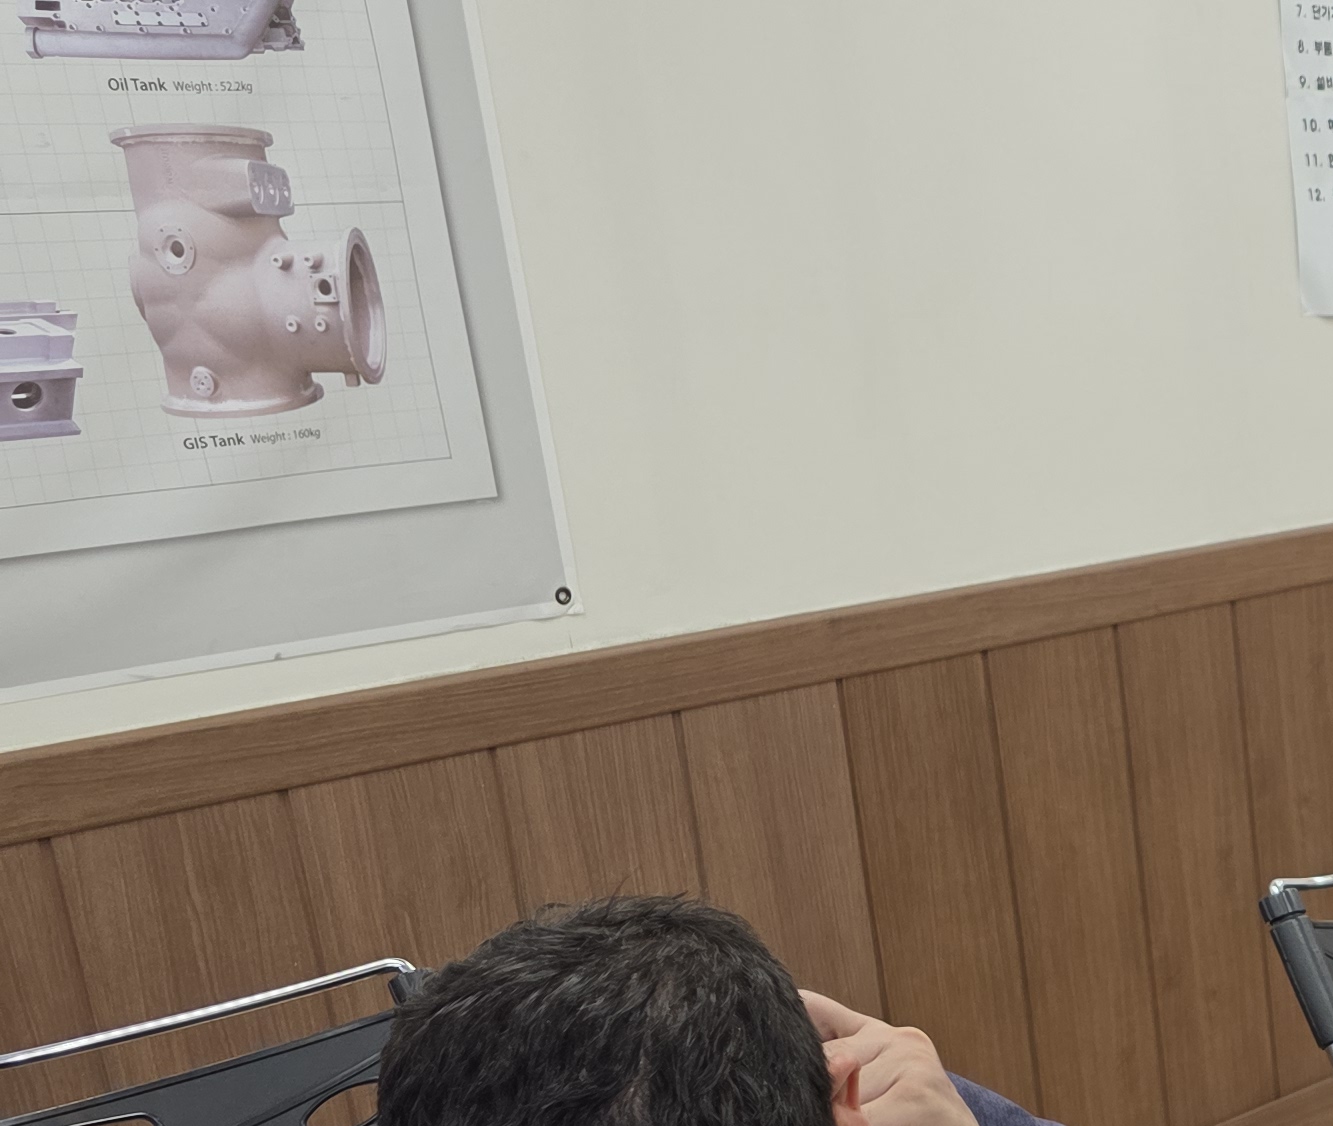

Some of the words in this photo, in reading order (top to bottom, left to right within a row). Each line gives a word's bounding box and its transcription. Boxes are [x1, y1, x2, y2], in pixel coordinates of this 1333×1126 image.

[107, 78, 129, 92] Oil
[131, 78, 168, 92] Tank
[173, 81, 213, 94] Weight
[1302, 118, 1321, 133] 10.
[1305, 153, 1323, 168] 11.
[1308, 188, 1325, 202] 12.
[183, 436, 208, 450] GIS
[208, 433, 246, 447] Tank
[250, 431, 286, 445] Weight
[293, 427, 321, 440] 160kg
